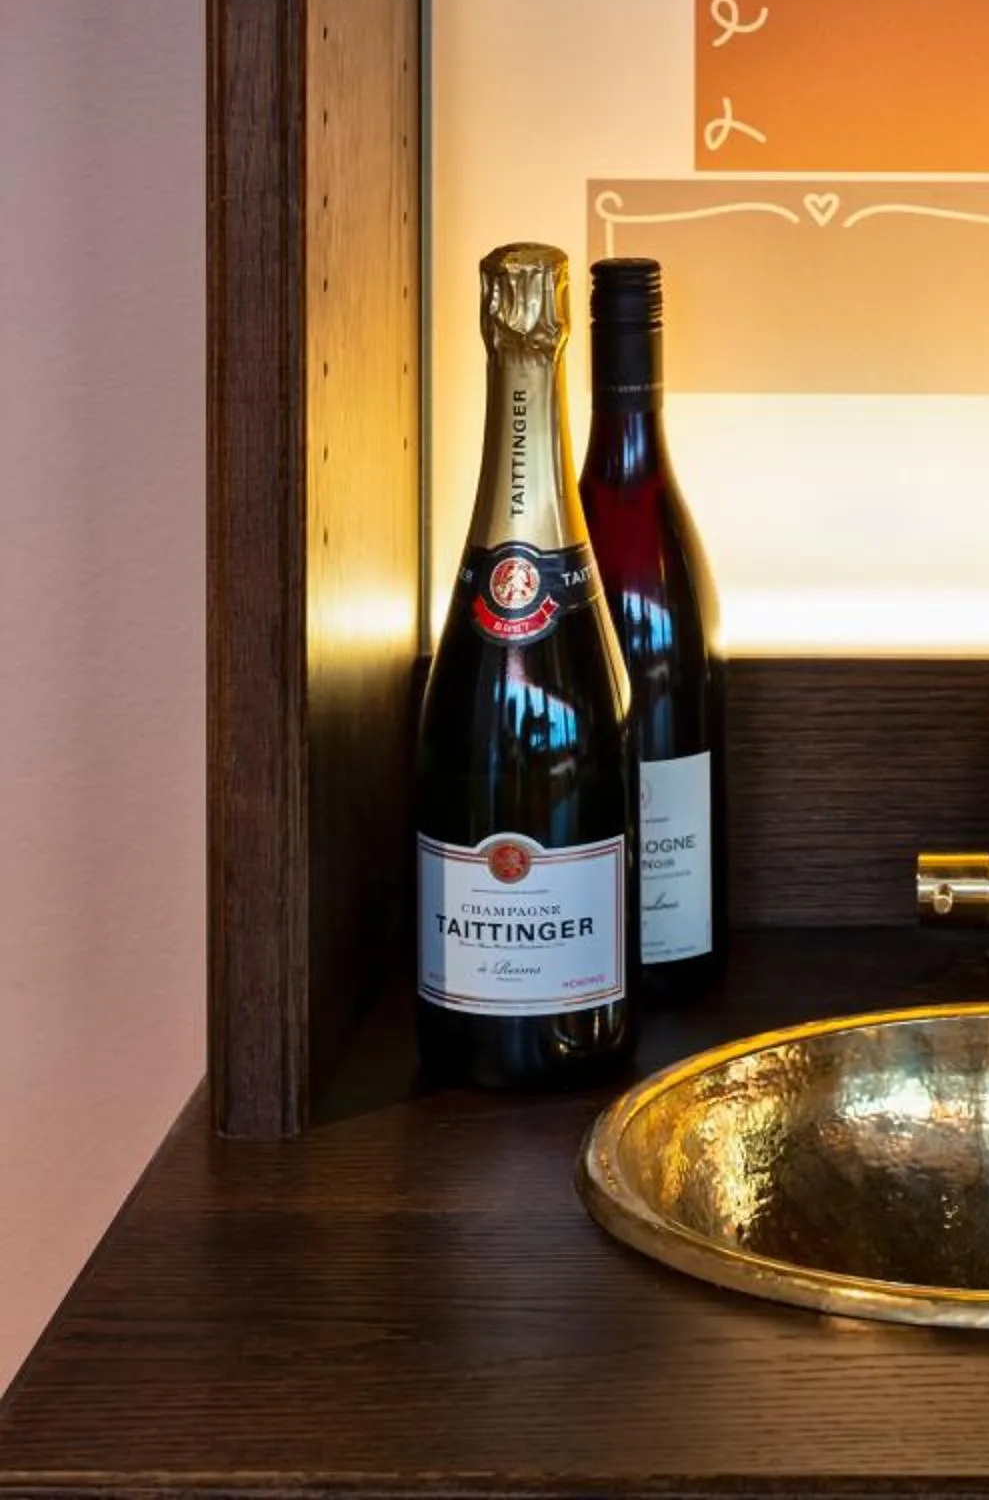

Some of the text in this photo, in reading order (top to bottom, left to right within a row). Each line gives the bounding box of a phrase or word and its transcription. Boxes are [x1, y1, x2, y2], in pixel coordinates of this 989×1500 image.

[510, 389, 527, 518] TAITTINGER
[460, 903, 562, 917] CHAMPAGNE
[435, 913, 595, 942] TAITTINGER
